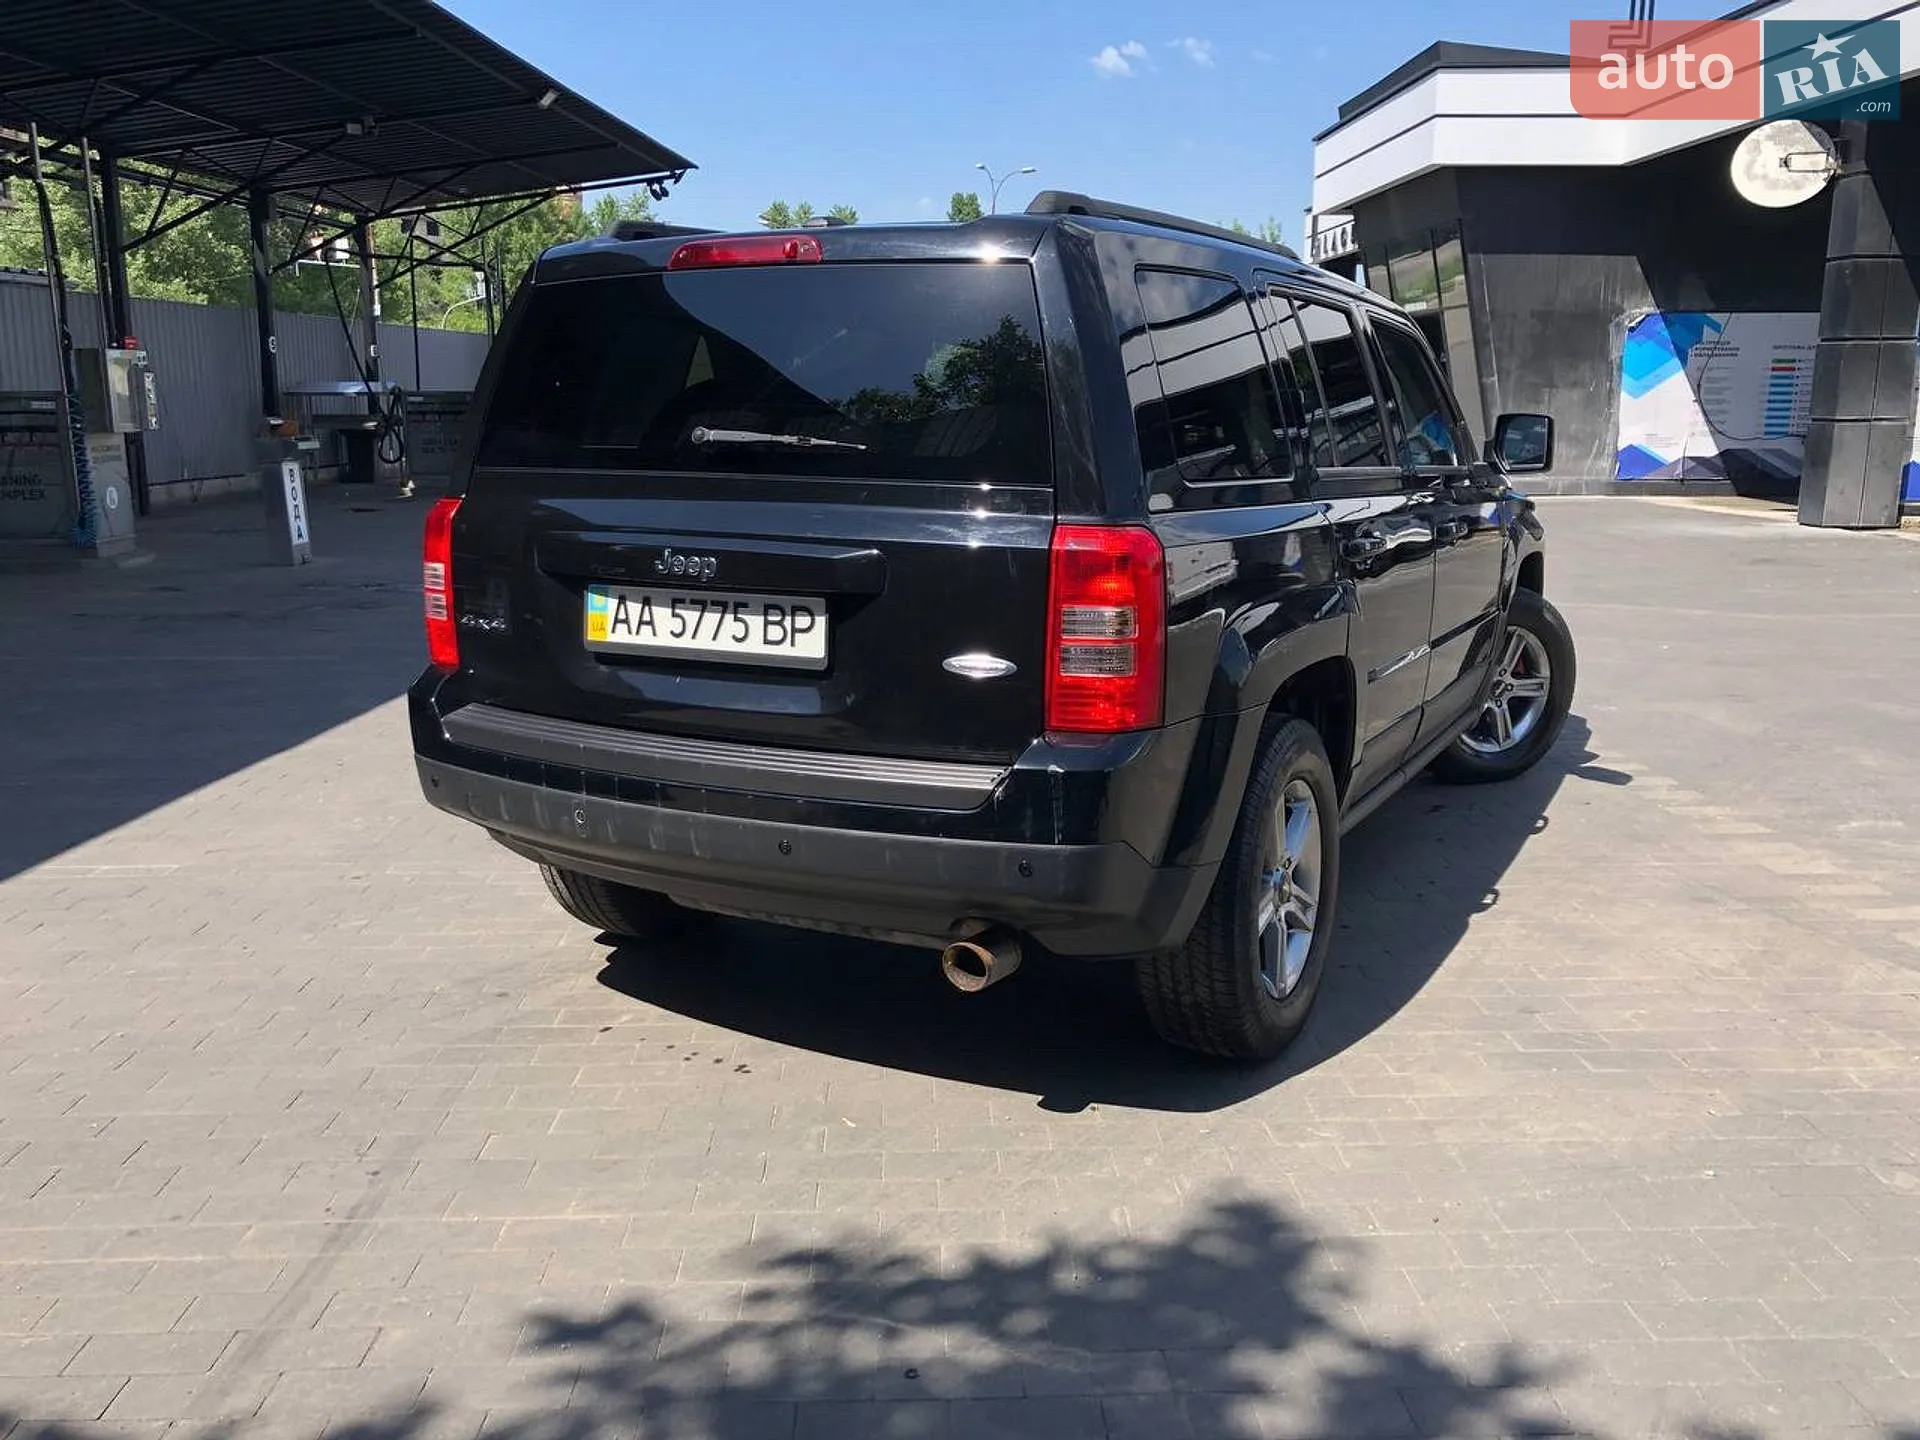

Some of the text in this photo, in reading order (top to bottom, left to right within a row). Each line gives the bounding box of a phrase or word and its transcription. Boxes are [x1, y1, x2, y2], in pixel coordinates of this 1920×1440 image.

[654, 548, 718, 581] Jeep
[611, 594, 816, 648] AA 5775 BP
